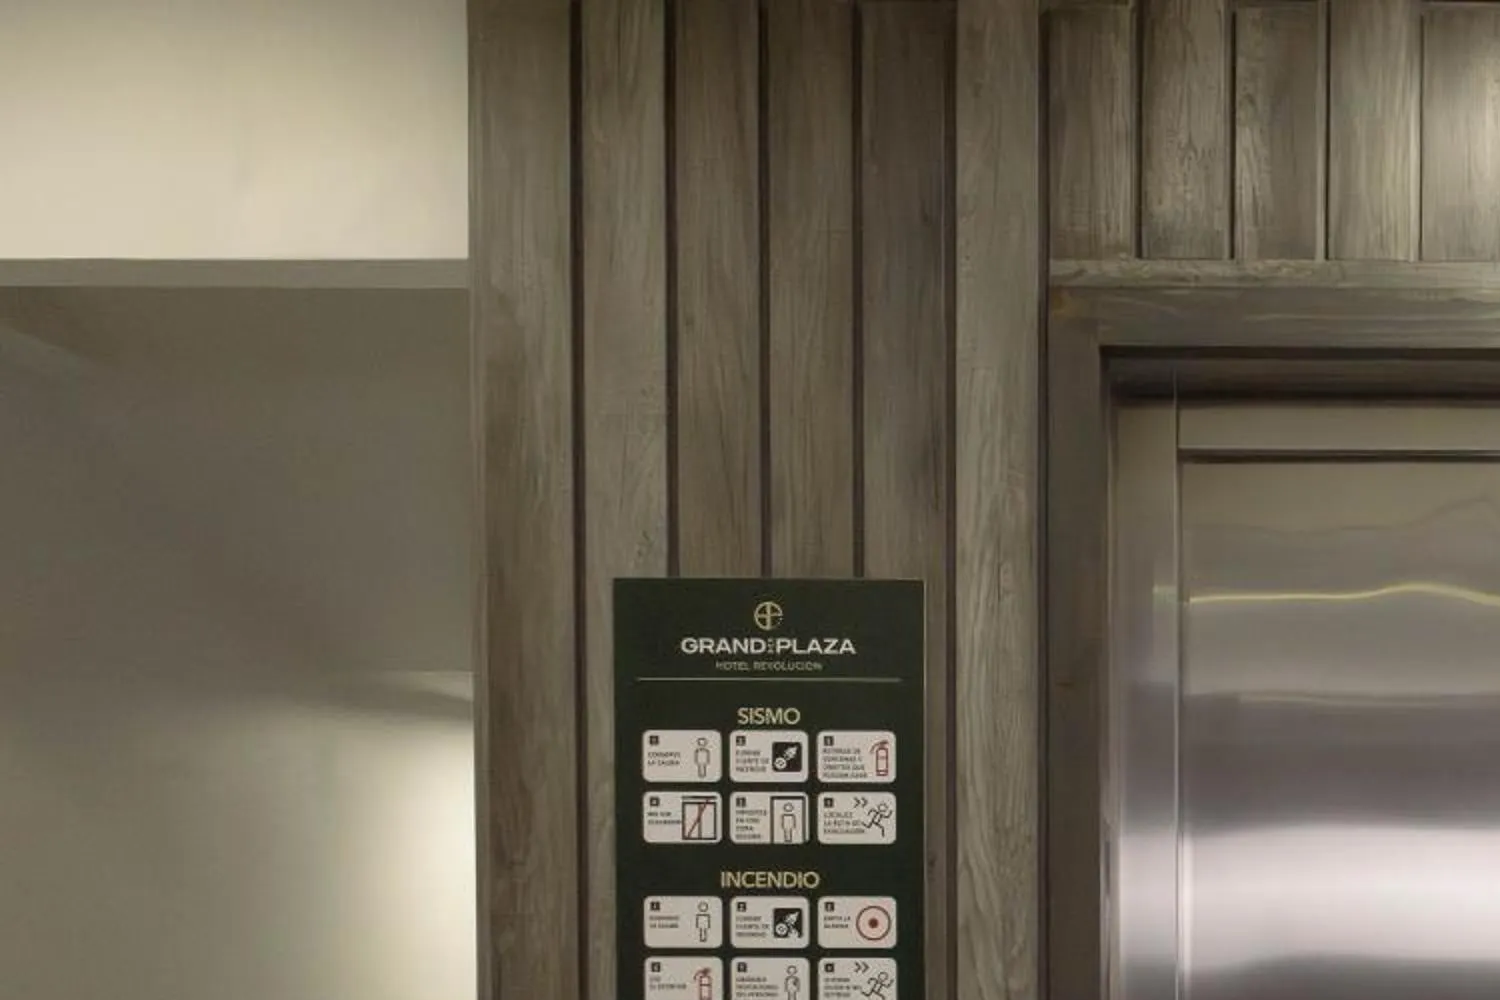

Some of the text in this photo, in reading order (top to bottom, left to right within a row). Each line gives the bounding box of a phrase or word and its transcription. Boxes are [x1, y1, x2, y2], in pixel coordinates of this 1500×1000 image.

[681, 637, 857, 655] GRAND PLAZA
[715, 660, 750, 671] HOTEL
[737, 707, 801, 725] SISMO
[721, 871, 821, 889] INCENDIO
